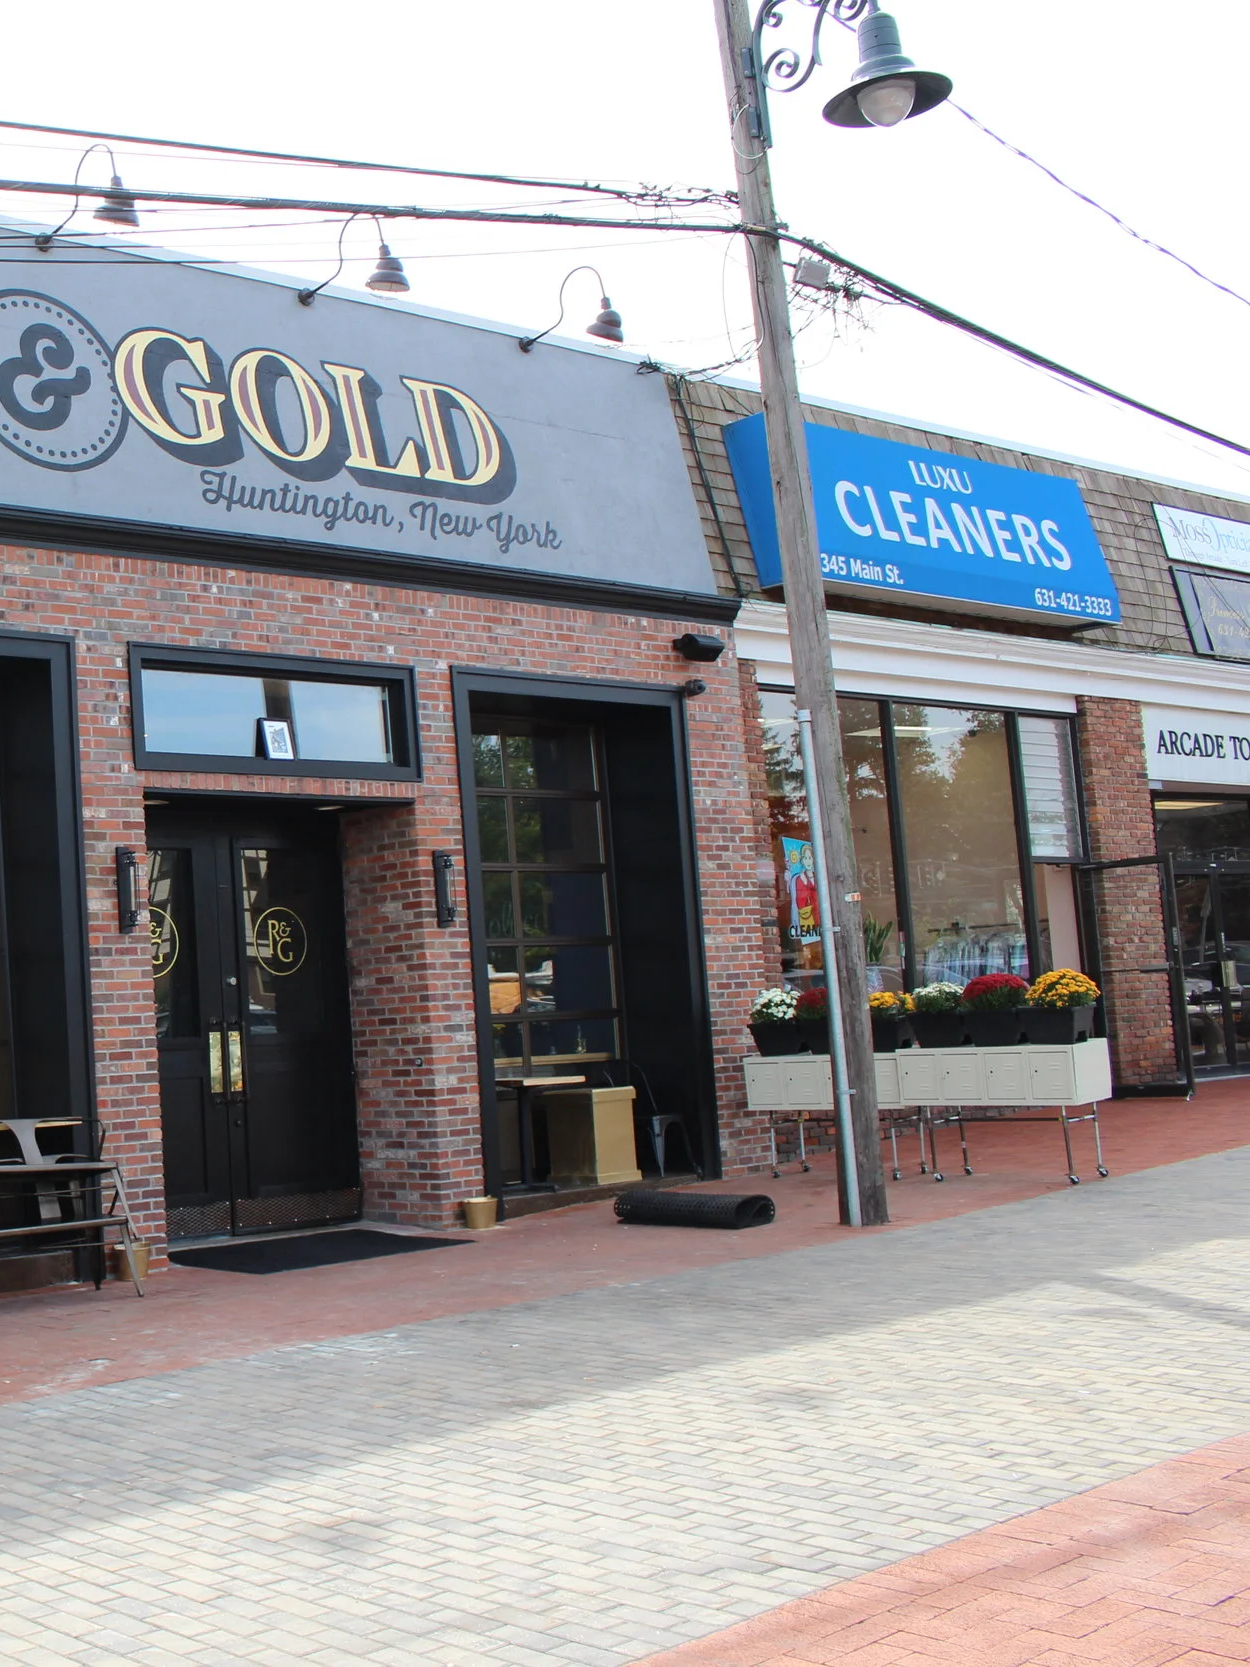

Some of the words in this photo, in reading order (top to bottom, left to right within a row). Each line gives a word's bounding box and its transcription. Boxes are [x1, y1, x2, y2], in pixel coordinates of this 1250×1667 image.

[113, 326, 518, 506] GOLD
[907, 459, 974, 495] LUXU
[199, 469, 405, 533] Huntington,
[409, 500, 483, 540] New
[486, 511, 563, 554] York
[833, 479, 1072, 572] CLEANERS
[820, 552, 848, 577] 345
[849, 557, 884, 584] Main
[885, 562, 905, 586] St.
[1034, 587, 1113, 617] 631-421-3333
[1156, 729, 1227, 759] ARCADE
